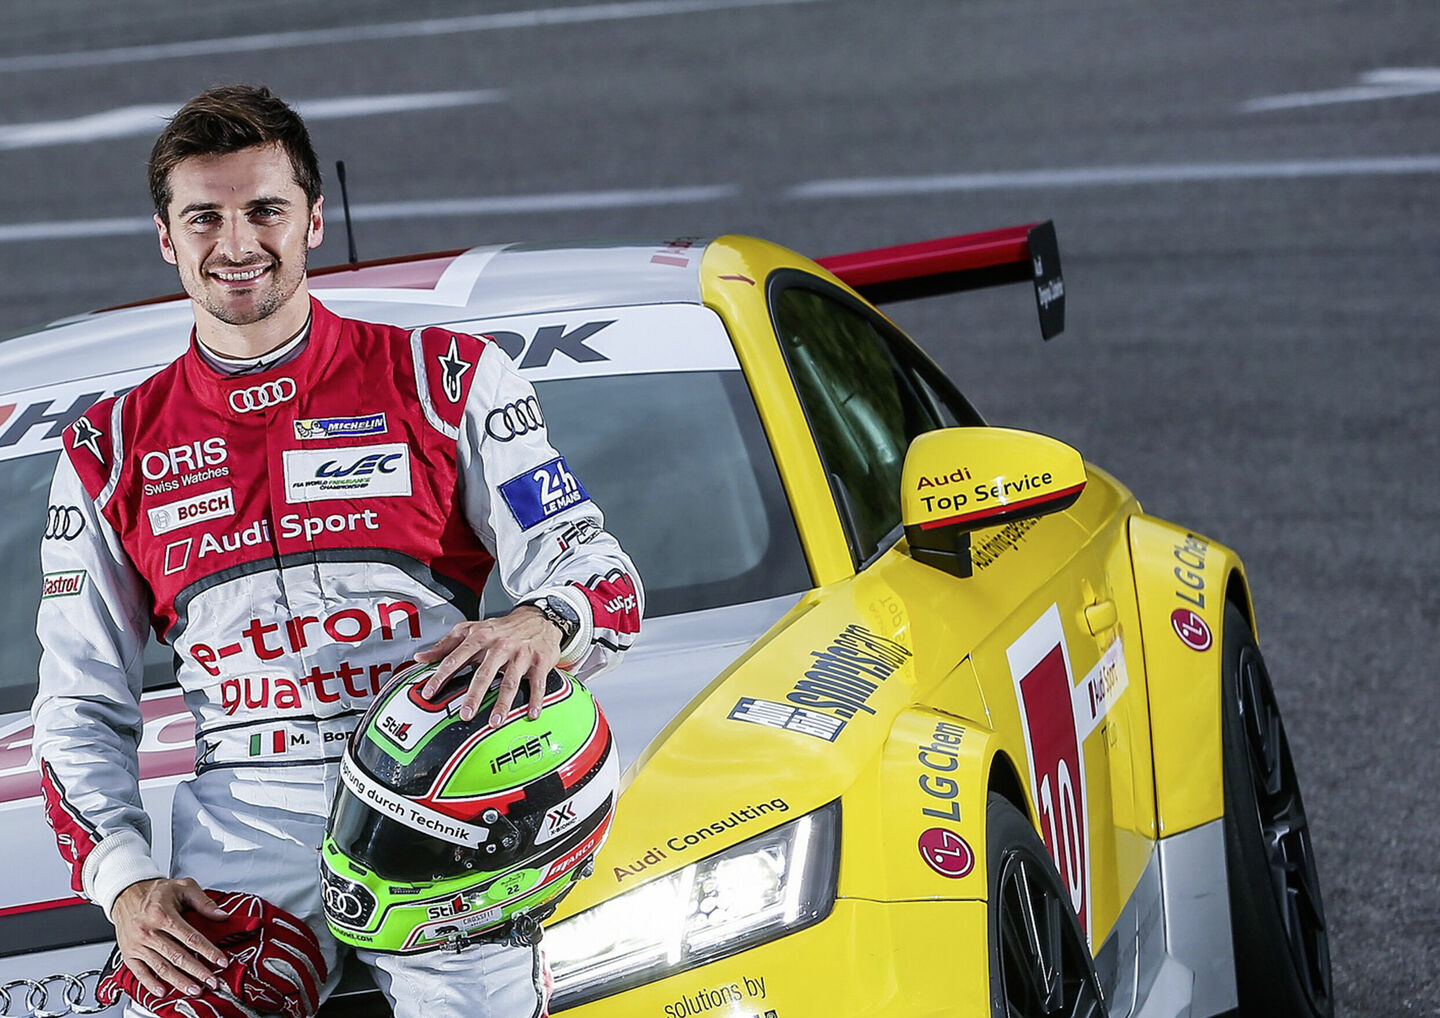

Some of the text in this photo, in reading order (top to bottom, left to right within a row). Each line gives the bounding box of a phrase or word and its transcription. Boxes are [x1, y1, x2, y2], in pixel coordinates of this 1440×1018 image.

[328, 417, 384, 432] MICHELIN
[141, 437, 229, 481] ORIS
[315, 453, 402, 478] WEC
[916, 467, 972, 491] Audi
[144, 465, 230, 497] Swiss Watches
[532, 461, 578, 506] 24h
[921, 471, 1052, 513] Top Service
[177, 494, 230, 520] BOSCH
[543, 490, 582, 516] LE MANS
[197, 508, 379, 558] Audi Sport
[1173, 565, 1206, 610] LG
[190, 599, 423, 677] e-tron
[290, 732, 310, 746] M.
[489, 730, 552, 775] iFAST
[918, 720, 967, 823] LG Chem
[367, 788, 406, 817] durch
[410, 809, 471, 841] Technik
[613, 797, 790, 883] Audi Consulting
[1040, 758, 1083, 916] 10
[506, 883, 521, 896] 22
[743, 975, 767, 999] by
